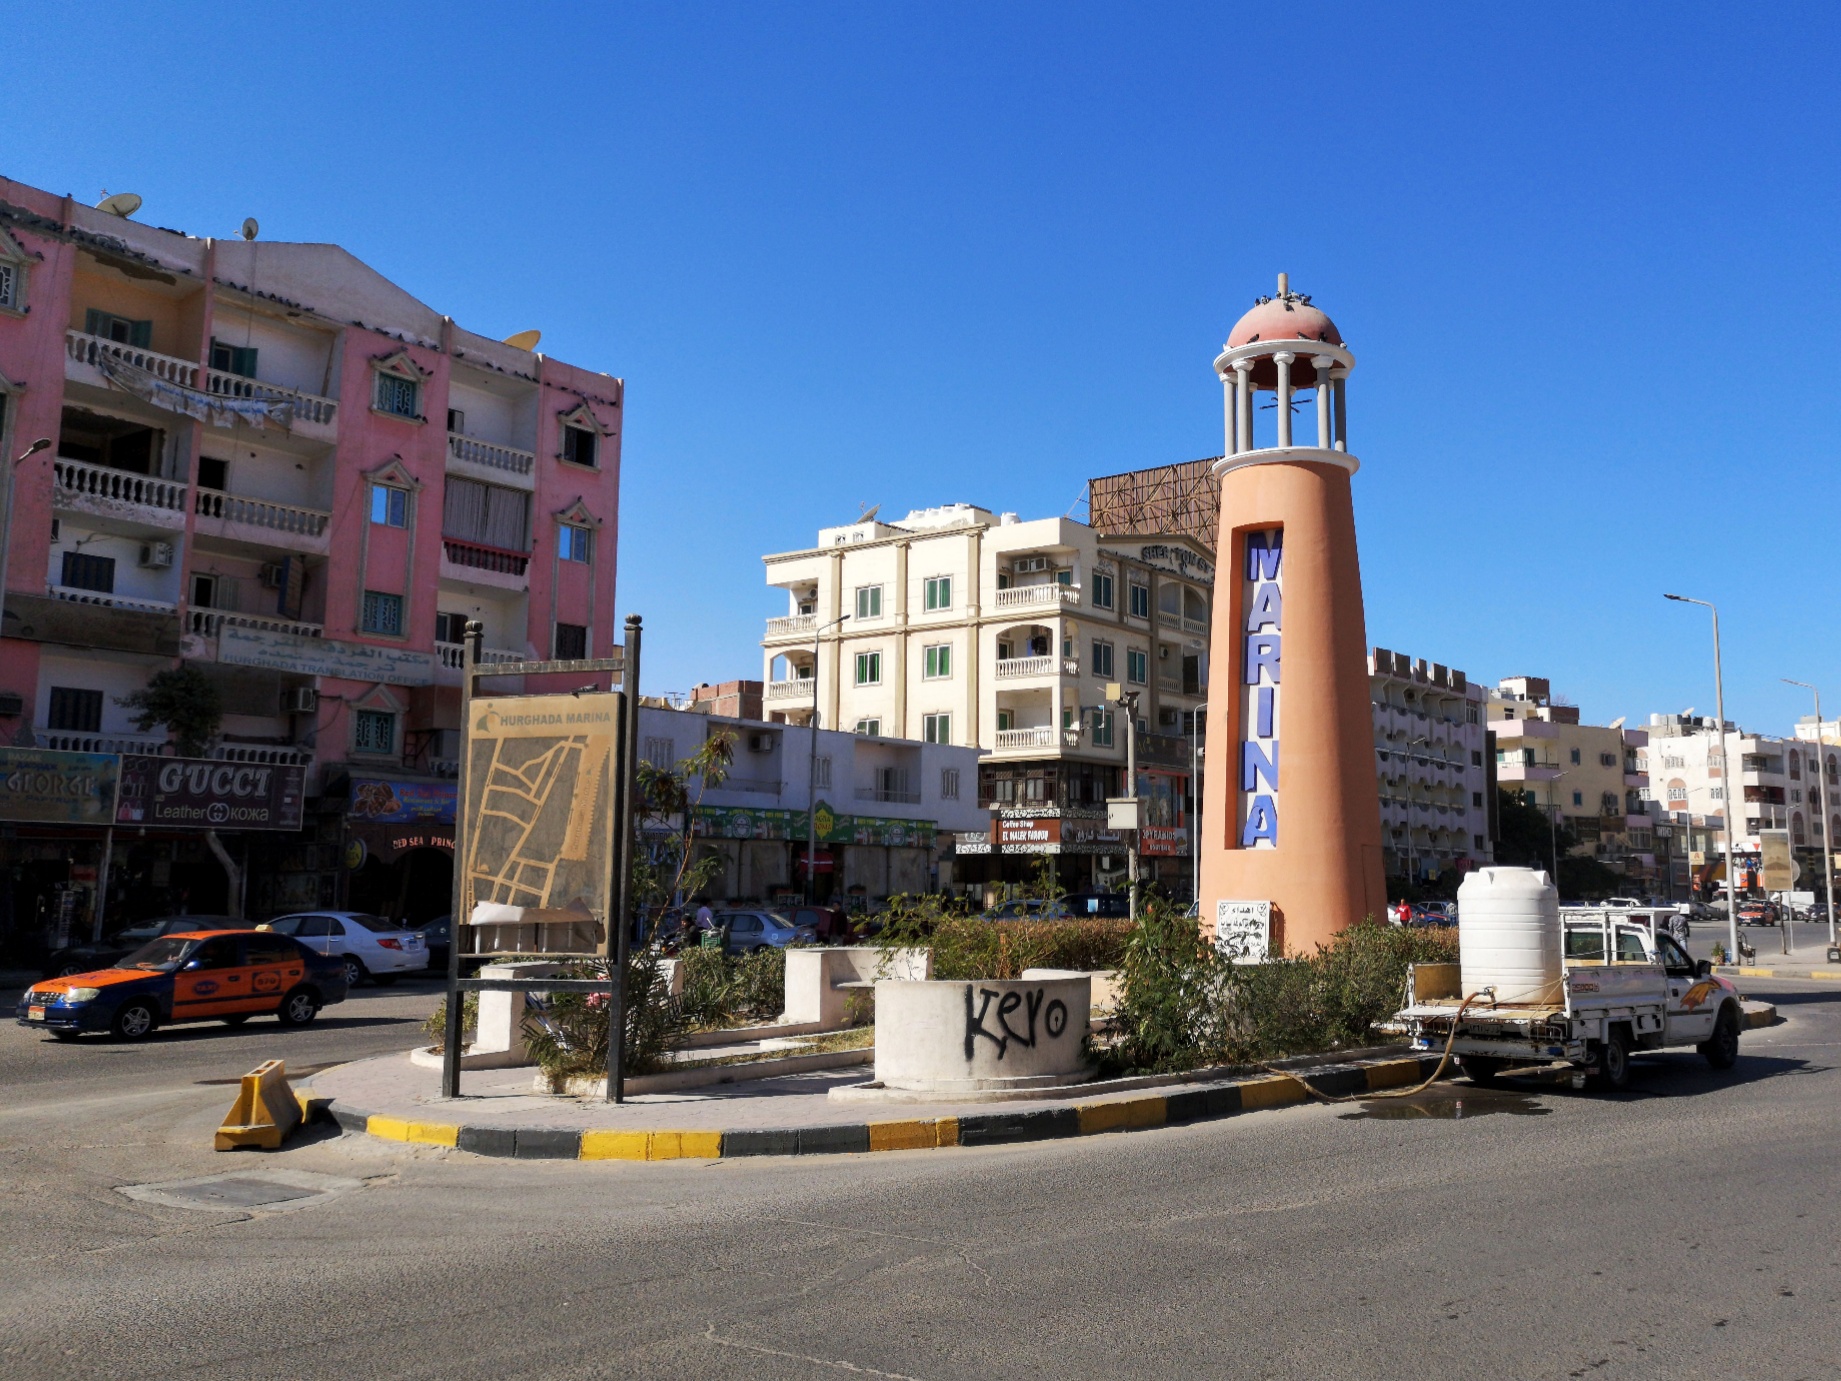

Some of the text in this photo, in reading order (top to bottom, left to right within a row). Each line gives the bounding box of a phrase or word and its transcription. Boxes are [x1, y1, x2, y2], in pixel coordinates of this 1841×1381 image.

[224, 653, 428, 687] HURGHADA TRANSLATION OFFICE
[1242, 530, 1284, 847] MARINA
[500, 711, 611, 727] HURGHADA MARINA
[159, 762, 273, 799] GUCCI
[155, 803, 207, 820] Leather
[1002, 820, 1034, 829] Coffee Shop
[409, 836, 424, 846] SEA
